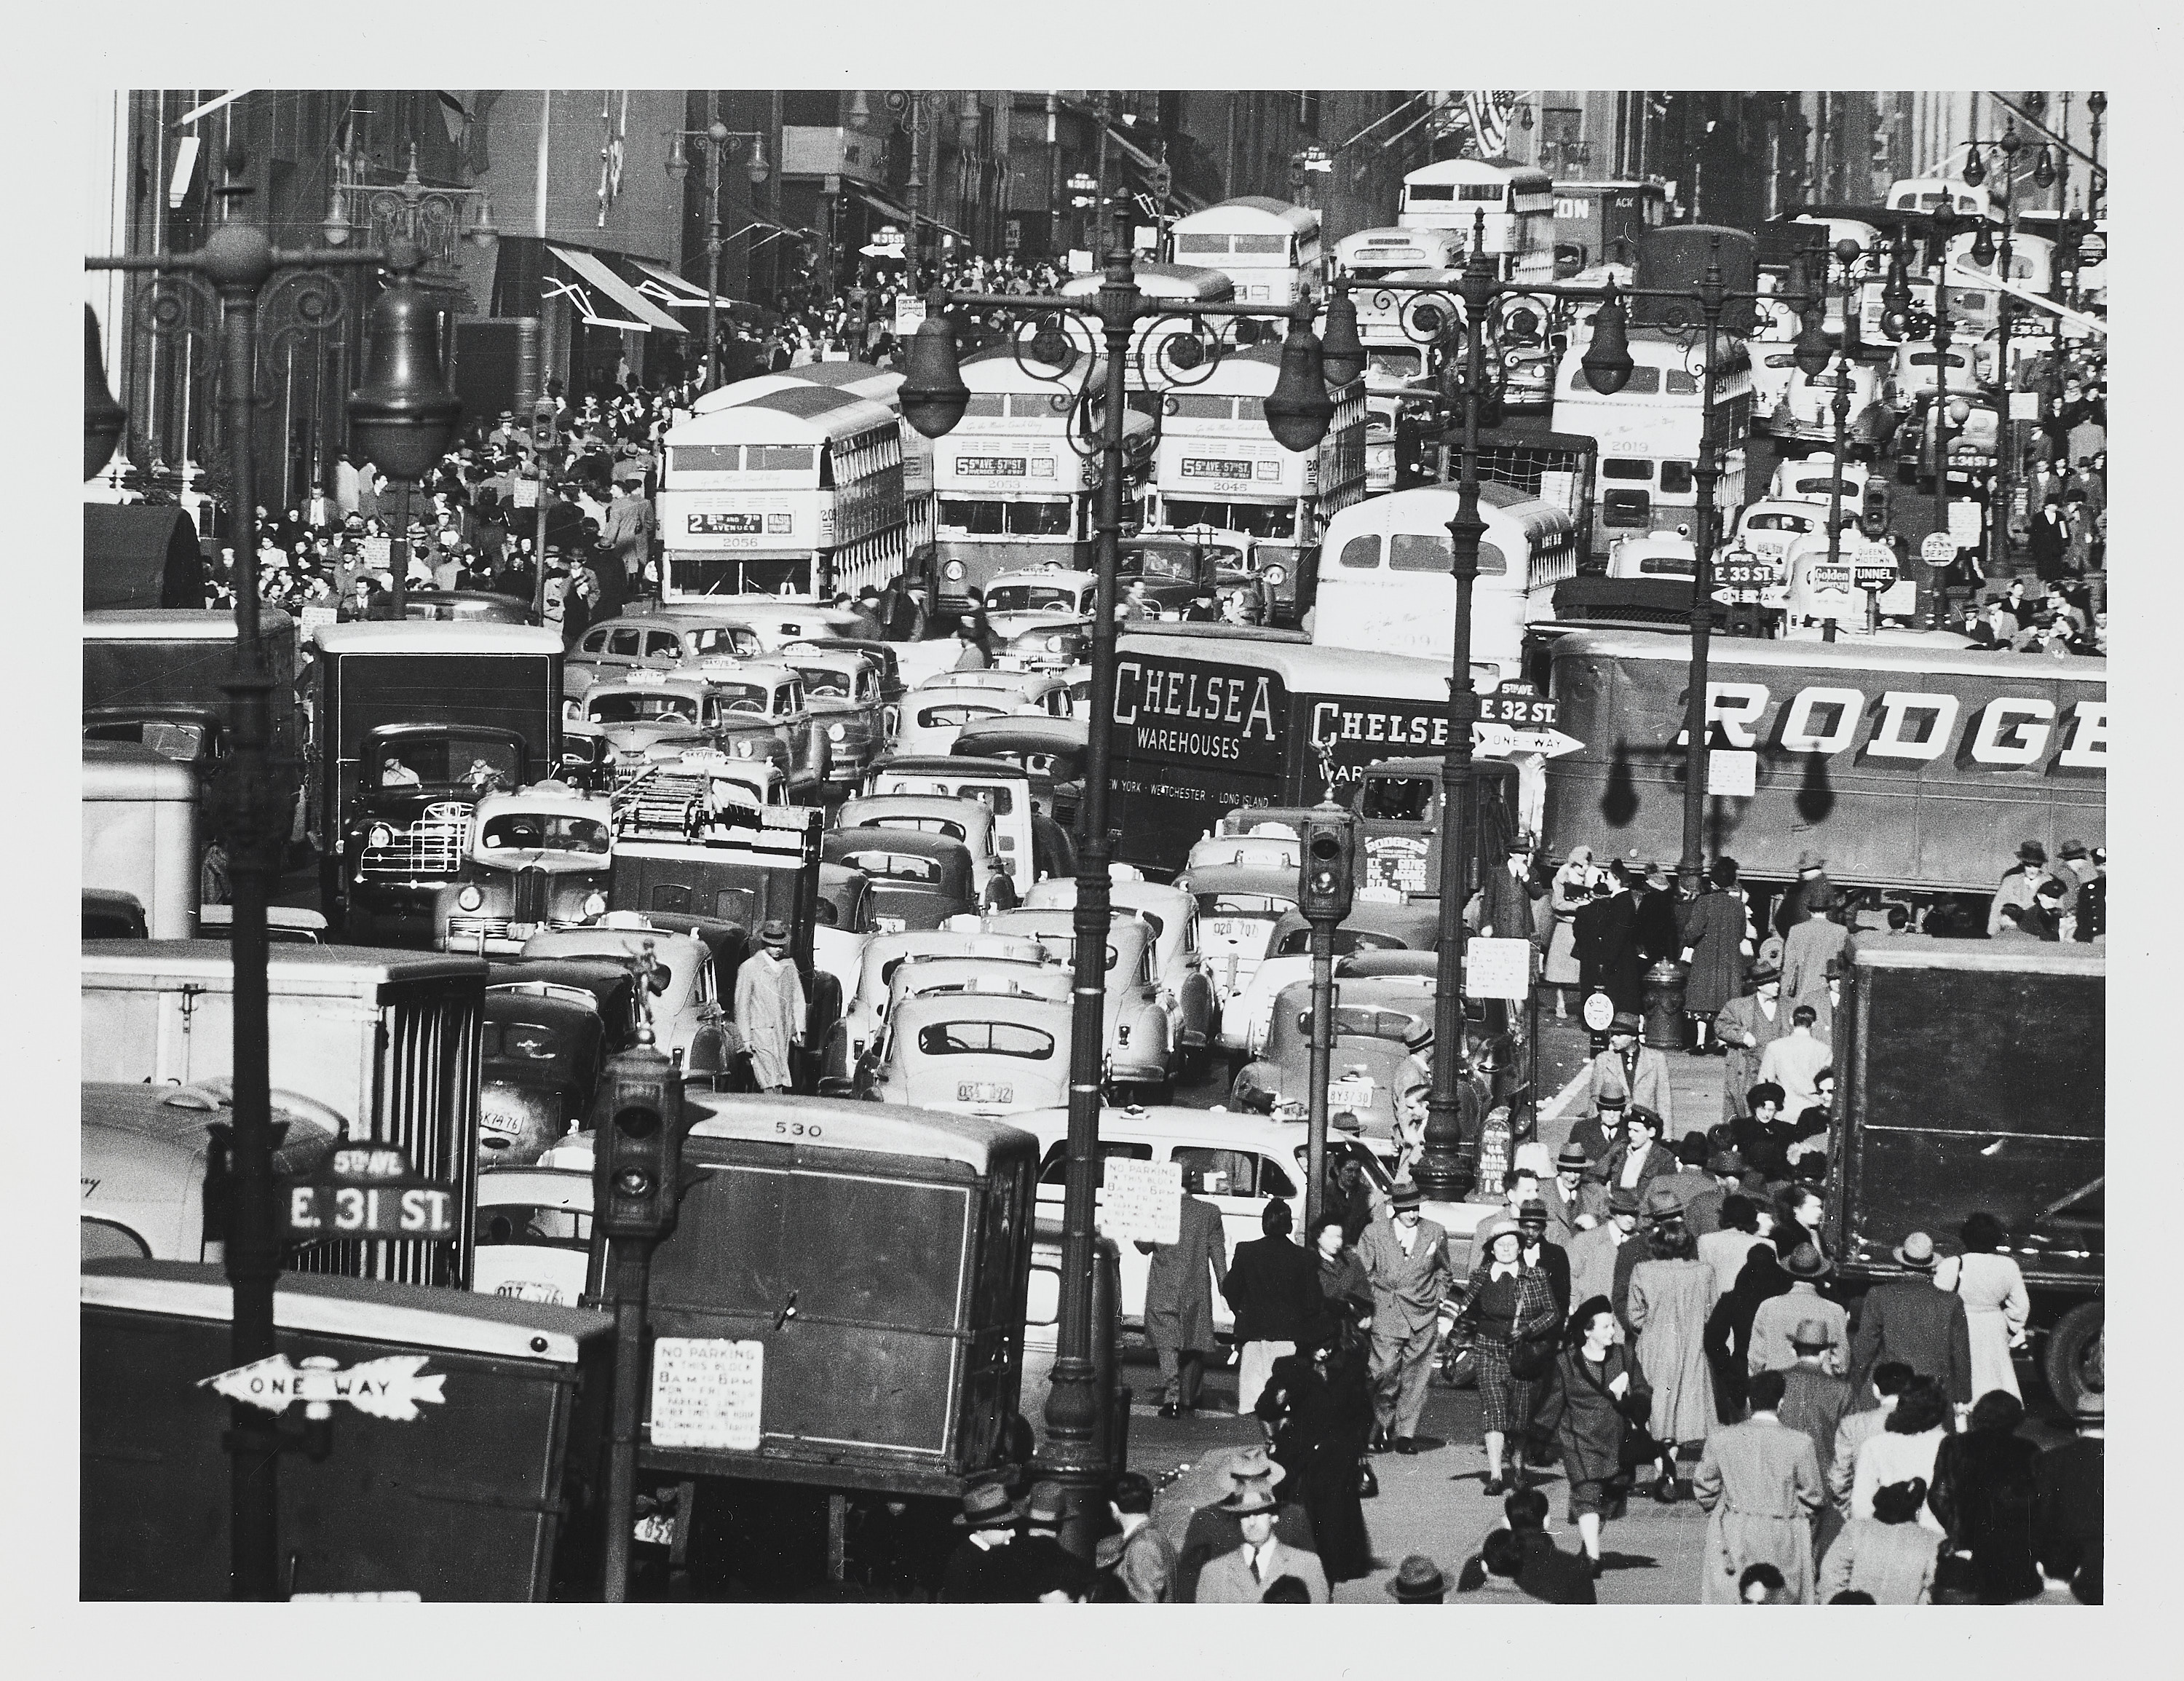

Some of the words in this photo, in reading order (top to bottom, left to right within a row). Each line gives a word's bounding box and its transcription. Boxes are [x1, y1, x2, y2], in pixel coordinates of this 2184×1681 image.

[1612, 441, 1648, 452] 2019
[957, 458, 969, 474] 5
[1184, 460, 1195, 477] 5
[988, 480, 1021, 489] 2053
[689, 514, 703, 531] 2
[723, 537, 758, 547] 2056
[1858, 548, 1887, 557] QUEENS
[1730, 567, 1750, 581] 33
[1816, 568, 1849, 580] Golden
[1517, 684, 1534, 696] AVE
[1112, 661, 1276, 741] CHELSEA
[1500, 701, 1527, 721] 32
[1531, 703, 1556, 723] ST.
[1137, 727, 1240, 760] WAREHOUSES
[1122, 780, 1142, 794] YORK
[1219, 792, 1240, 805] LONG
[1242, 794, 1269, 808] ISLAND
[1365, 836, 1428, 855] RODGERS
[1367, 858, 1382, 869] ICC
[1588, 997, 1610, 1008] BUS
[775, 1121, 822, 1137] 530
[1110, 1163, 1124, 1173] NO
[1129, 1165, 1176, 1177] PARKING
[1123, 1174, 1142, 1183] THIS
[1107, 1182, 1115, 1192] 8
[1150, 1185, 1158, 1195] 6
[291, 1187, 321, 1228] E.
[334, 1187, 379, 1231] 31
[400, 1189, 452, 1231] ST.
[662, 1347, 682, 1358] NO
[690, 1348, 754, 1360] PARKING
[660, 1372, 669, 1383] 8
[719, 1373, 727, 1385] 6
[250, 1377, 304, 1396] ONE
[334, 1378, 389, 1396] WAY
